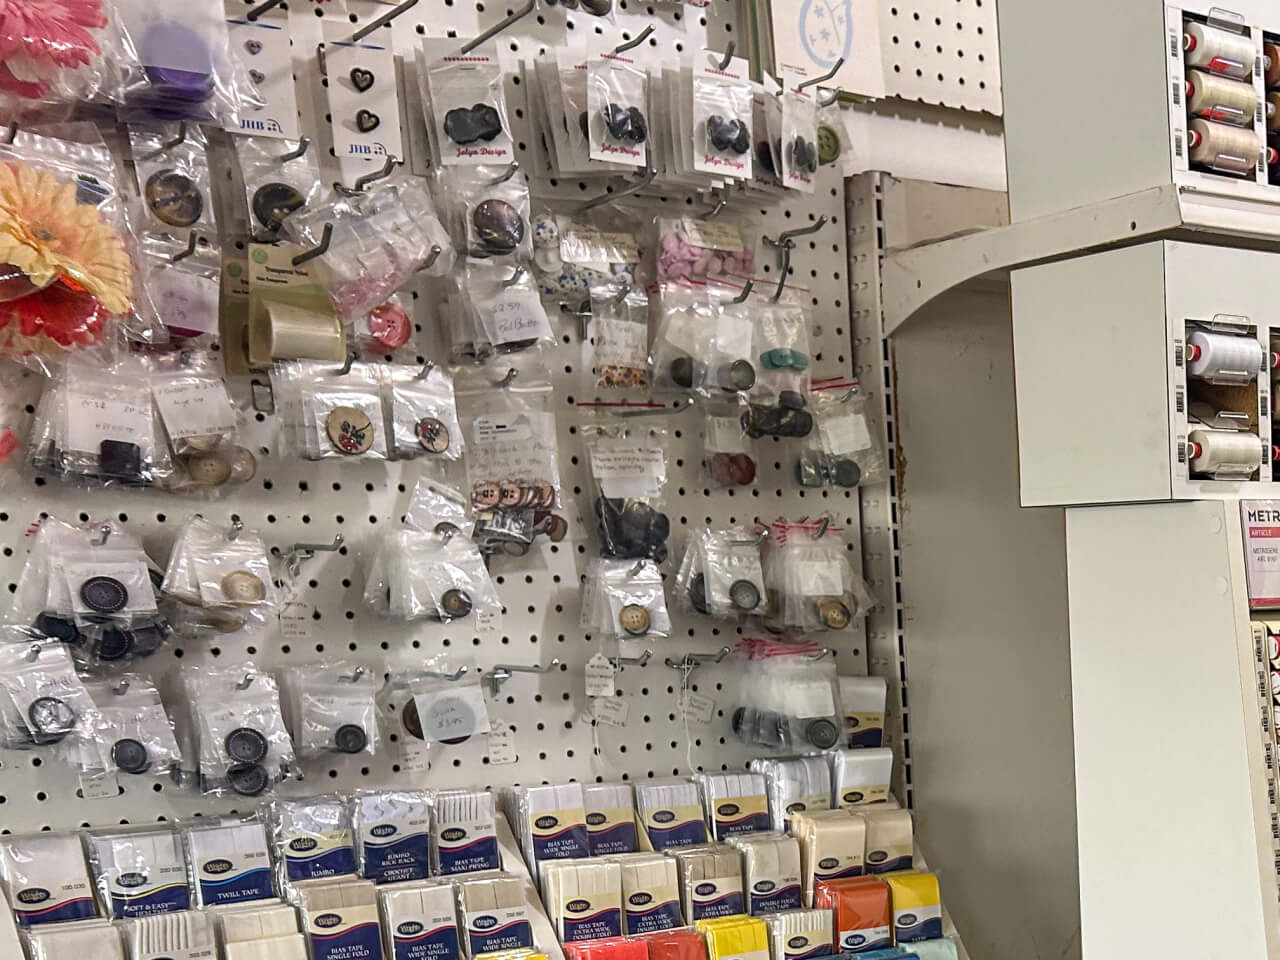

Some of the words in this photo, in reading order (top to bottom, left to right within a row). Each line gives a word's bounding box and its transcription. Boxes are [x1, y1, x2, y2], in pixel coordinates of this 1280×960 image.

[217, 892, 238, 900] TWILL
[242, 888, 260, 897] TAPE
[349, 944, 364, 952] TAPE
[429, 942, 444, 950] TAPE
[327, 951, 351, 960] SINGLE
[352, 949, 369, 957] FOLD
[407, 950, 426, 958] WIDE
[427, 948, 449, 956] SINGLE
